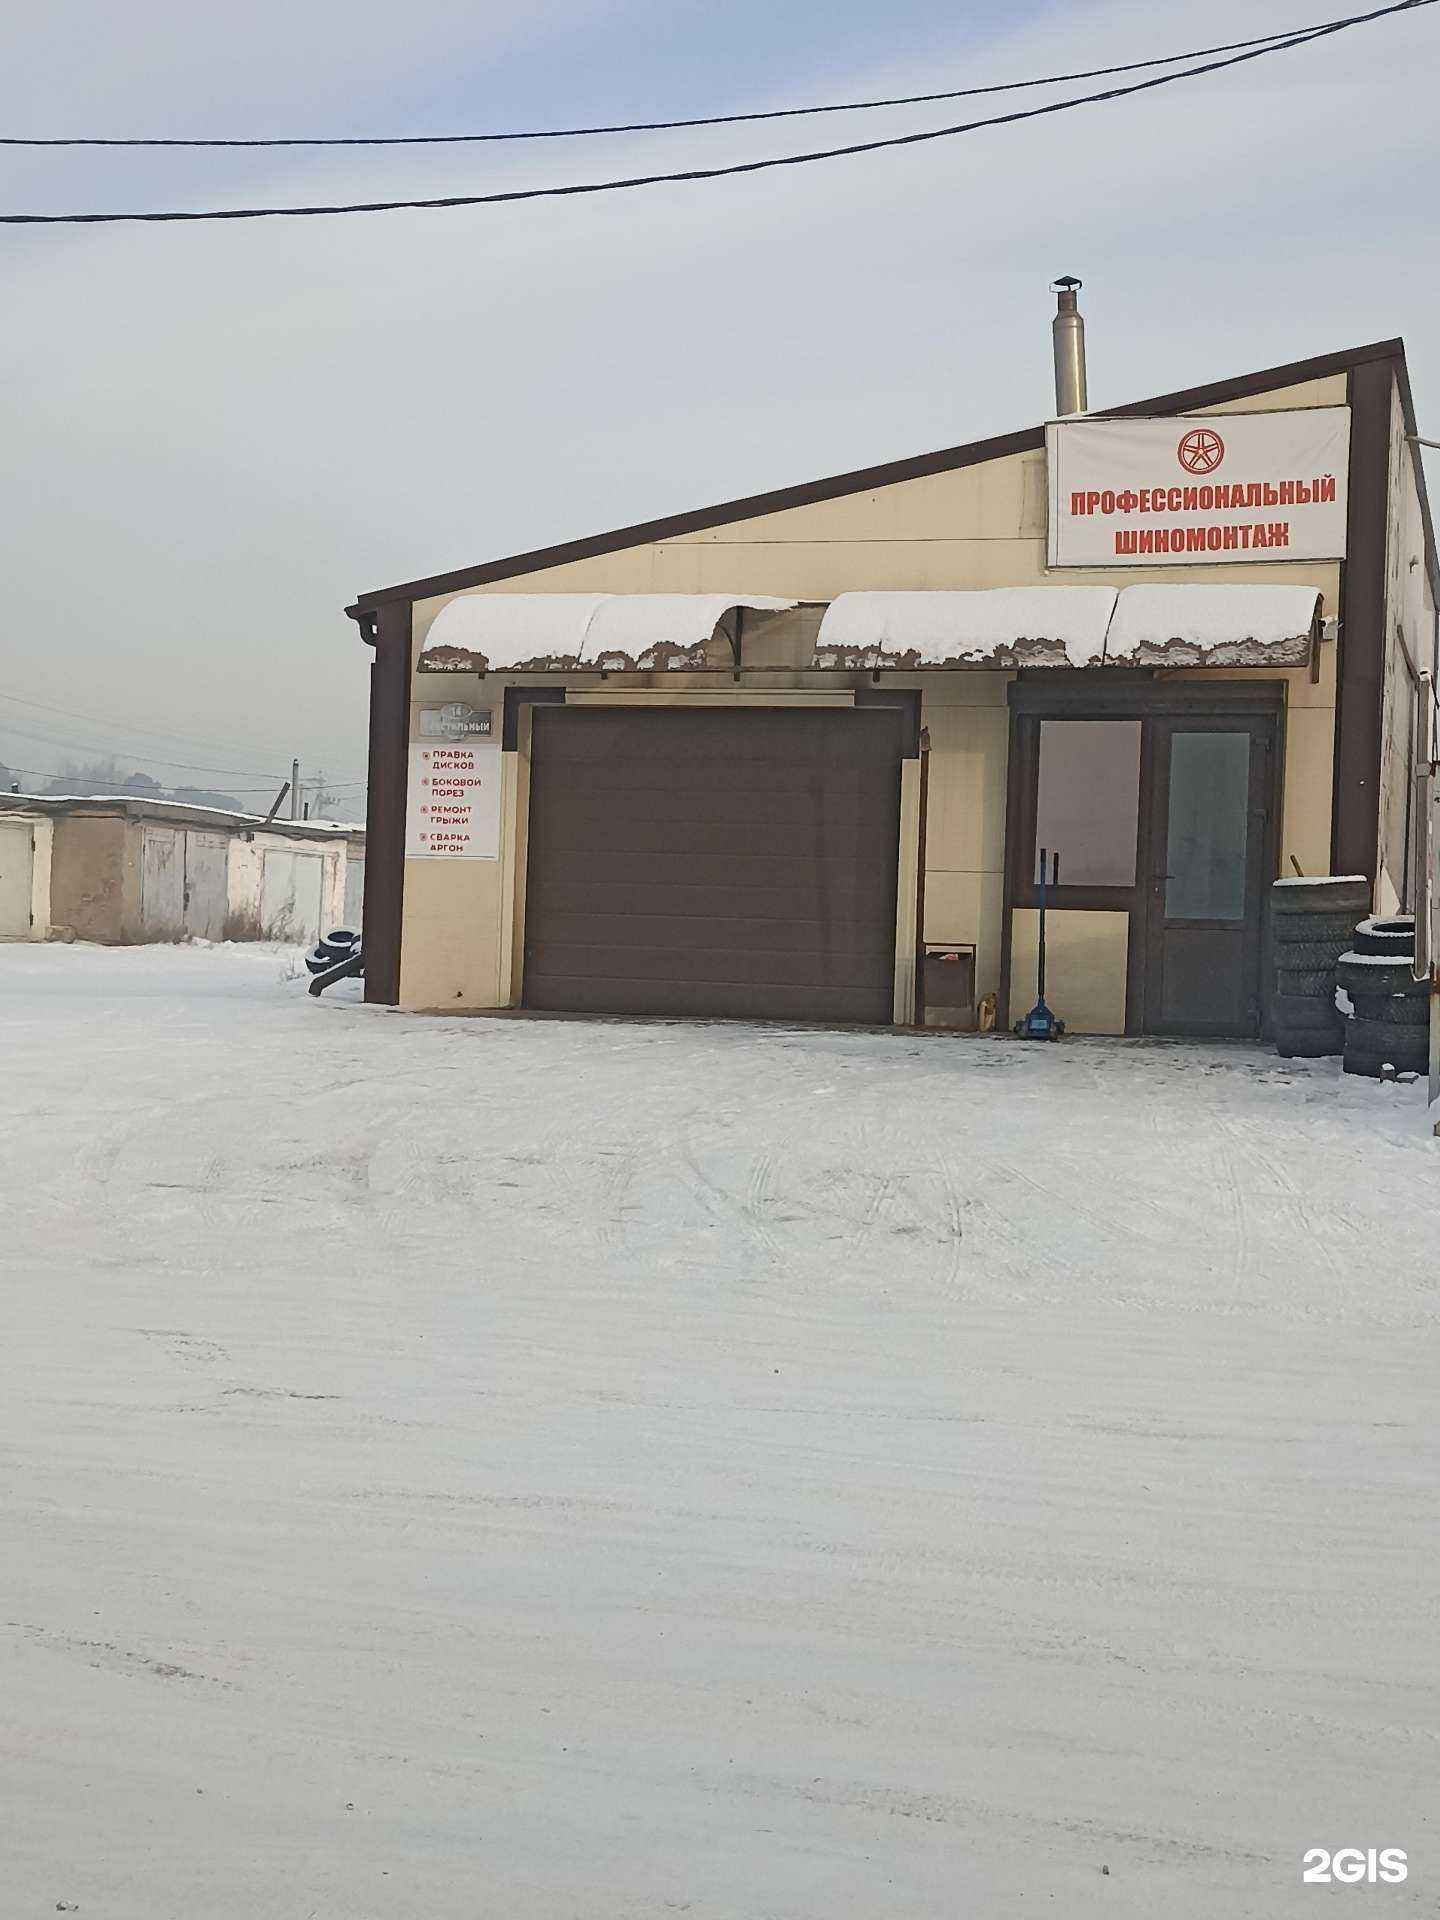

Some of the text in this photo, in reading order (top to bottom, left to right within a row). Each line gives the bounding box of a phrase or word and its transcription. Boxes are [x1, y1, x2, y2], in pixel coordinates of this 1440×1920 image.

[1070, 474, 1336, 515] ПРОФЕССИОНАЛЬНЫЙ
[1115, 522, 1289, 554] ШИНОМОНТАЖ
[433, 751, 474, 759] ПРАВКА
[432, 761, 475, 770] ДИСКОВ
[432, 777, 482, 787] БОКОВОЙ
[431, 789, 465, 798] ПОРЕЗ
[431, 806, 472, 814] РЕМОНТ
[430, 817, 469, 825] ГРЫЖИ
[430, 833, 470, 842] СВАРКА
[430, 844, 464, 853] АРГОН
